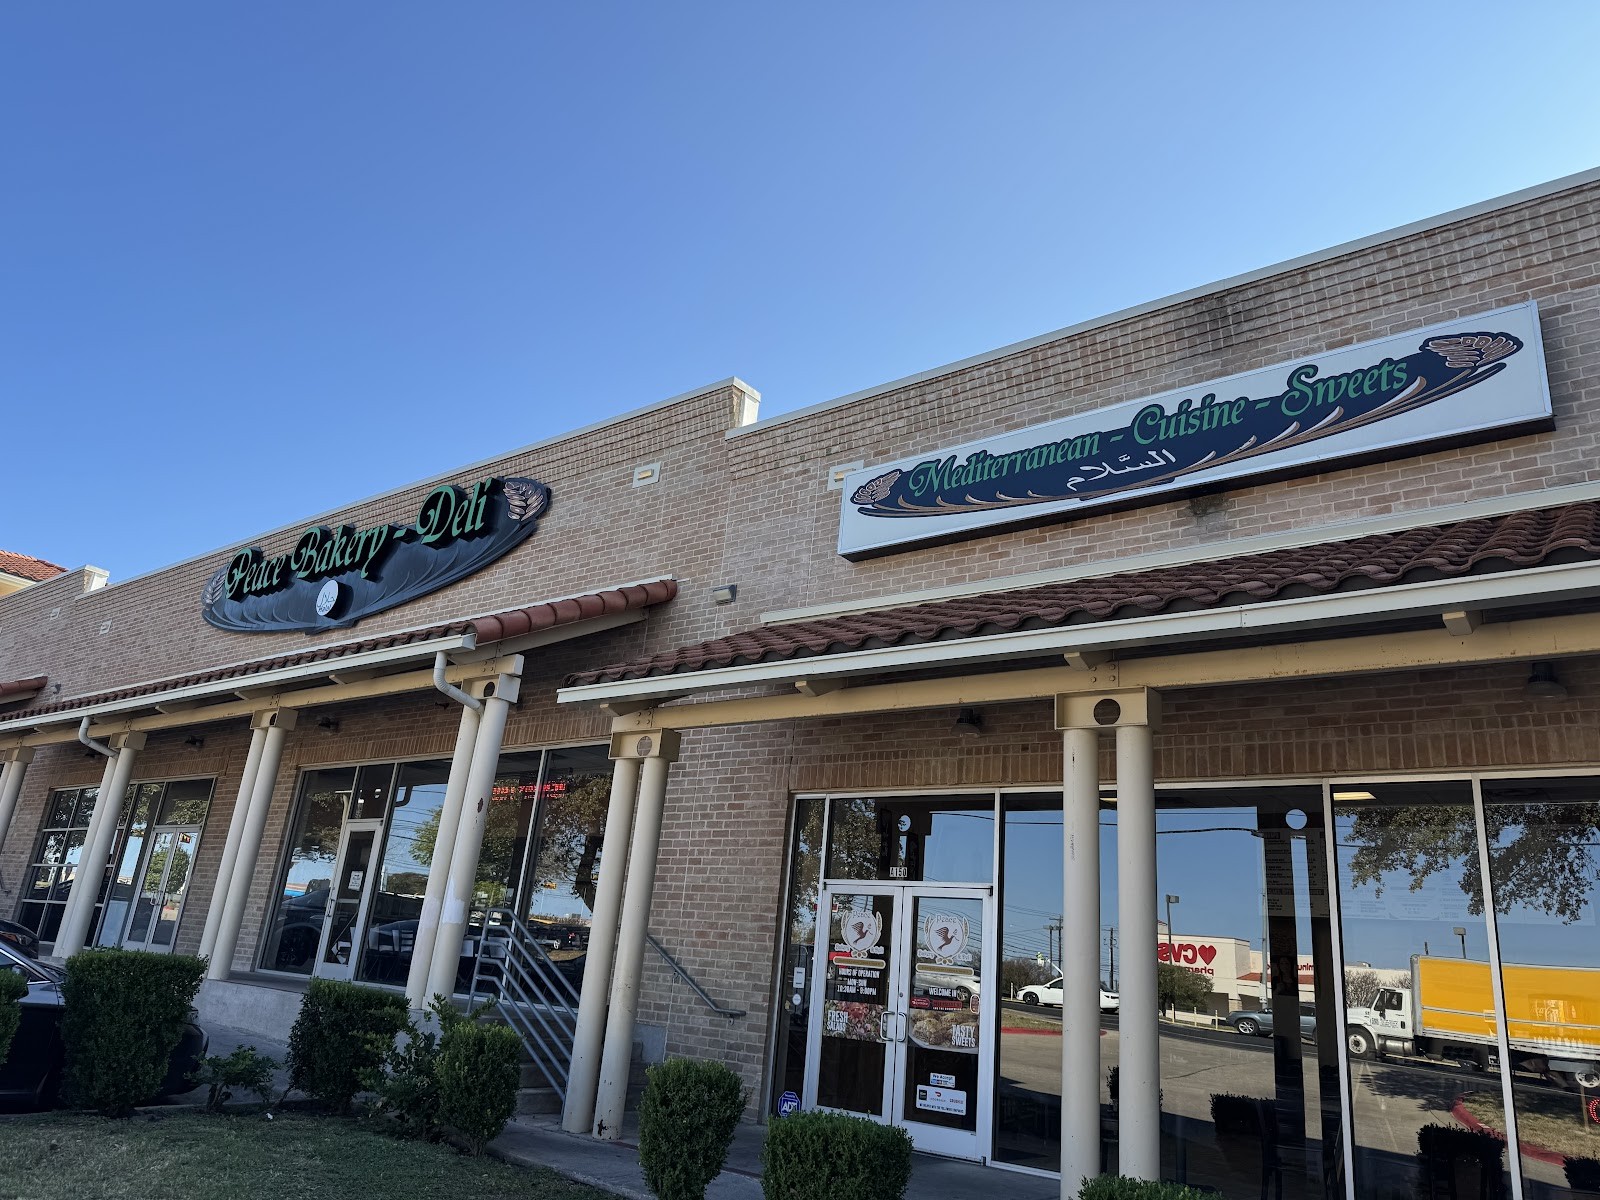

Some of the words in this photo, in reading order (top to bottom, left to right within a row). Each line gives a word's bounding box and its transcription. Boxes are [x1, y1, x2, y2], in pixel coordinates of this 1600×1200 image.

[908, 431, 1100, 499] Mediterranean
[1130, 394, 1246, 446] Cuisine
[1281, 363, 1410, 417] Sweets
[224, 547, 286, 600] Peace
[290, 526, 388, 579] Bakery
[416, 477, 493, 545] Deli
[936, 914, 958, 924] Peace
[838, 967, 852, 976] HOURS
[852, 969, 858, 977] OF
[857, 970, 880, 979] OPERATION
[928, 987, 952, 997] WELCOME
[951, 989, 958, 997] IN
[827, 1010, 849, 1023] FRESH
[826, 1021, 847, 1032] SALADS
[951, 1024, 976, 1037] TASTY
[951, 1036, 976, 1048] SWEETS
